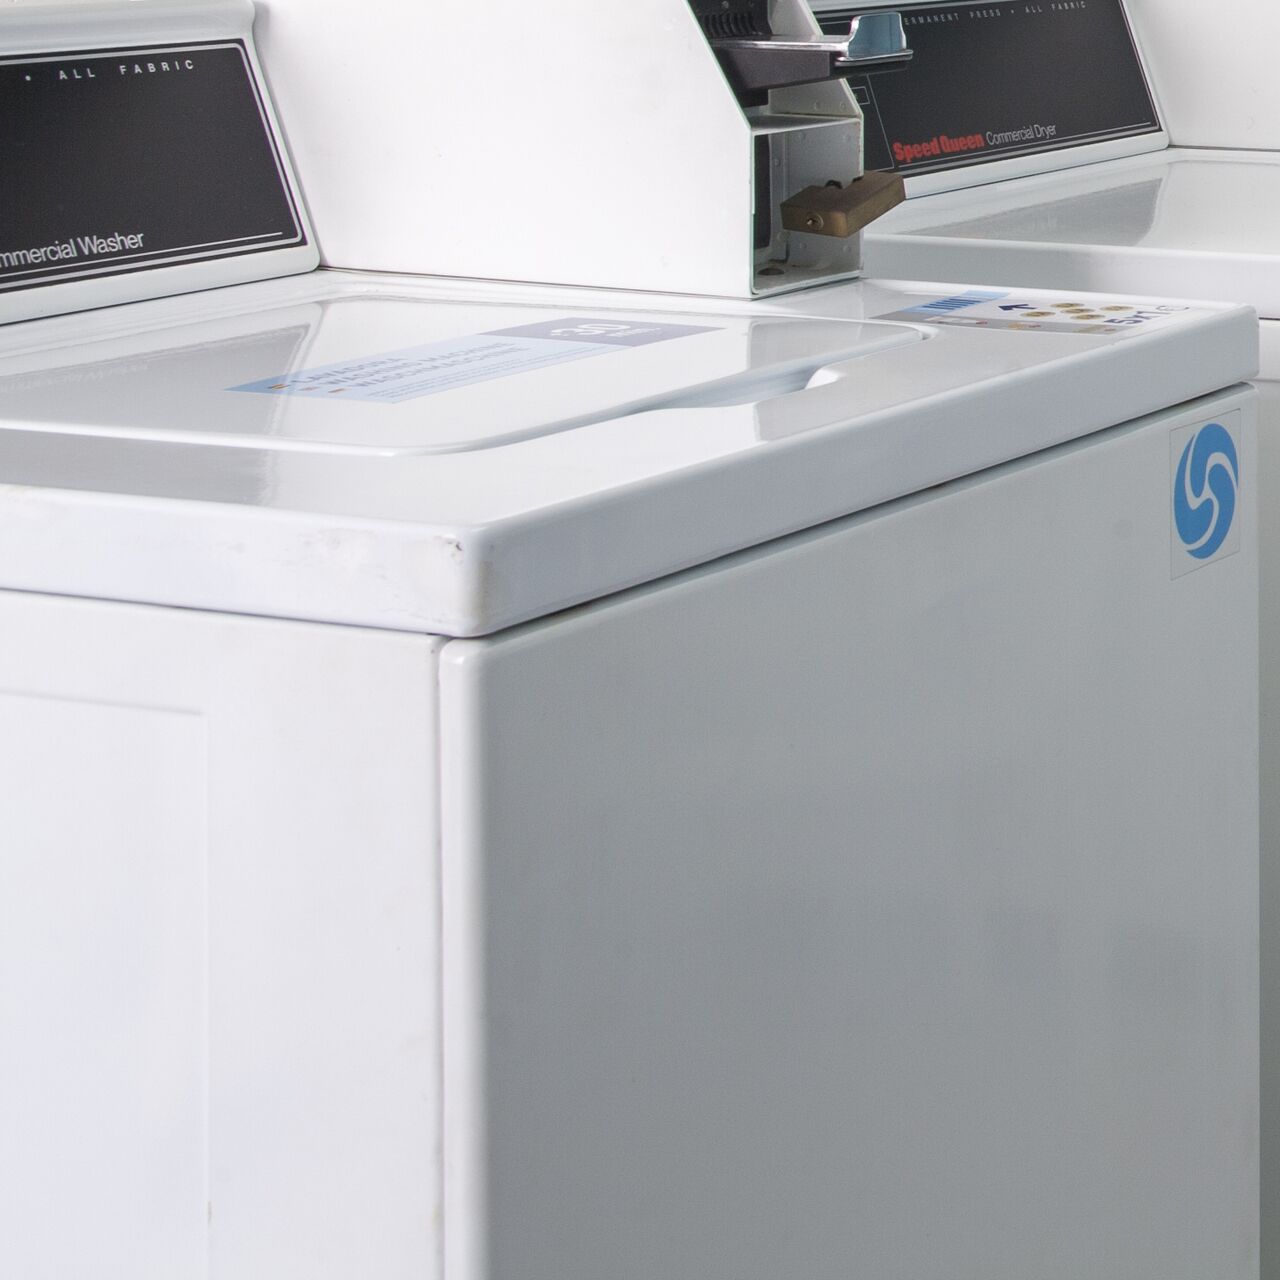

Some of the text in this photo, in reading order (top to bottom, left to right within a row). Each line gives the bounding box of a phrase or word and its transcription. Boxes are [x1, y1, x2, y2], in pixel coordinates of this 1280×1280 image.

[904, 0, 1087, 26] ERMANENT PRESS ALL FABRIC
[58, 59, 195, 80] ALL FABRIC
[893, 123, 1057, 162] Speed Queen Commercial Dryer
[77, 232, 144, 256] Washer
[551, 323, 631, 337] 30
